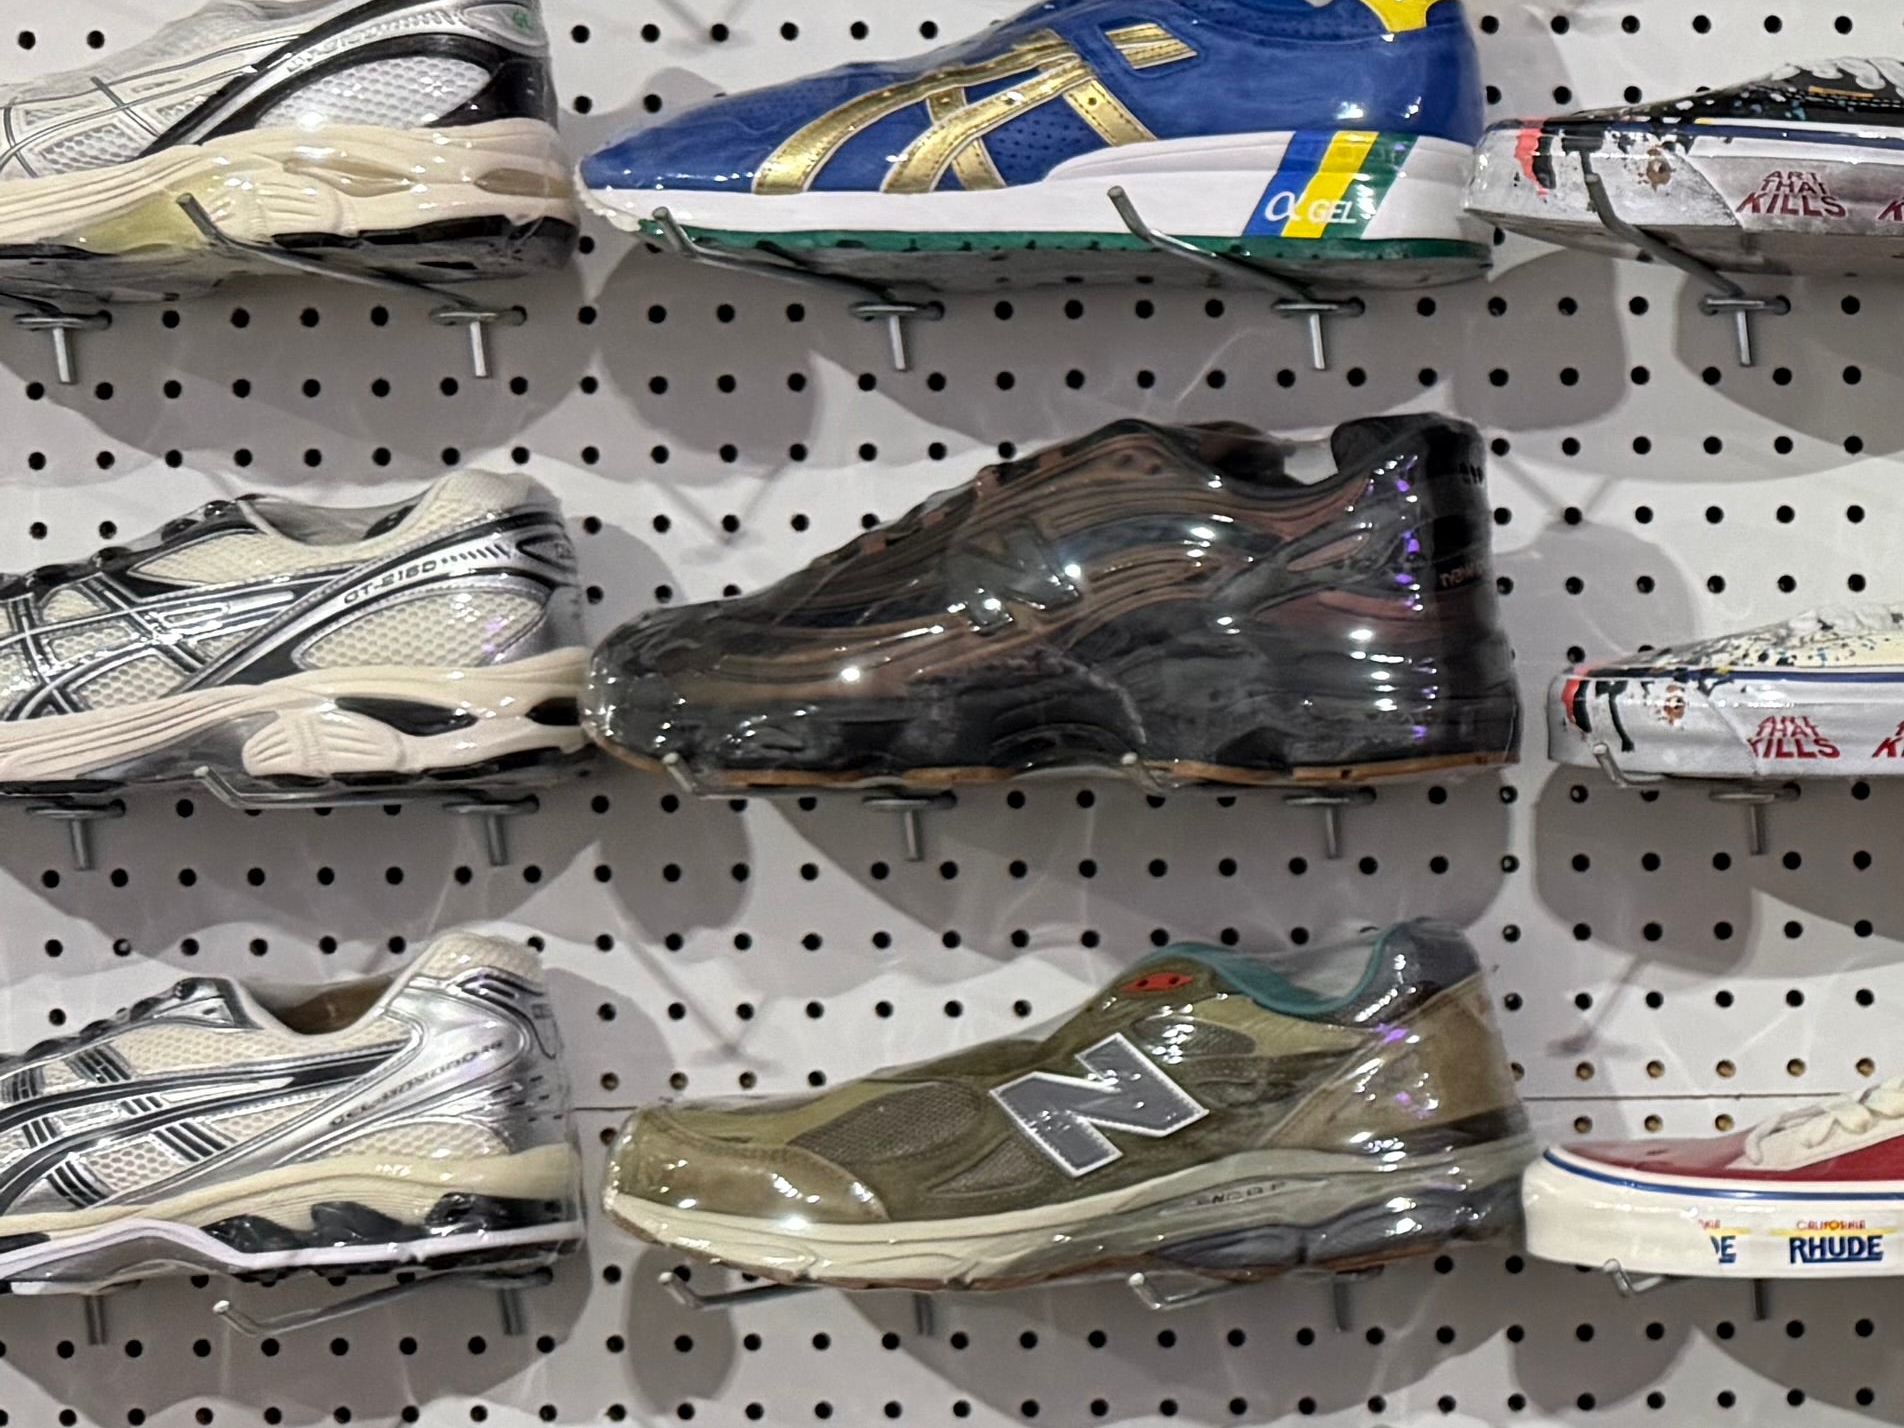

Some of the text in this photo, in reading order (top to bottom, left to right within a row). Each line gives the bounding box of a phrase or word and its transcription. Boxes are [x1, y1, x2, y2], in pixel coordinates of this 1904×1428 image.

[1307, 199, 1357, 224] GEL
[1736, 191, 1848, 218] KILLS
[988, 1031, 1210, 1179] N
[1789, 1234, 1885, 1264] RHUDE
